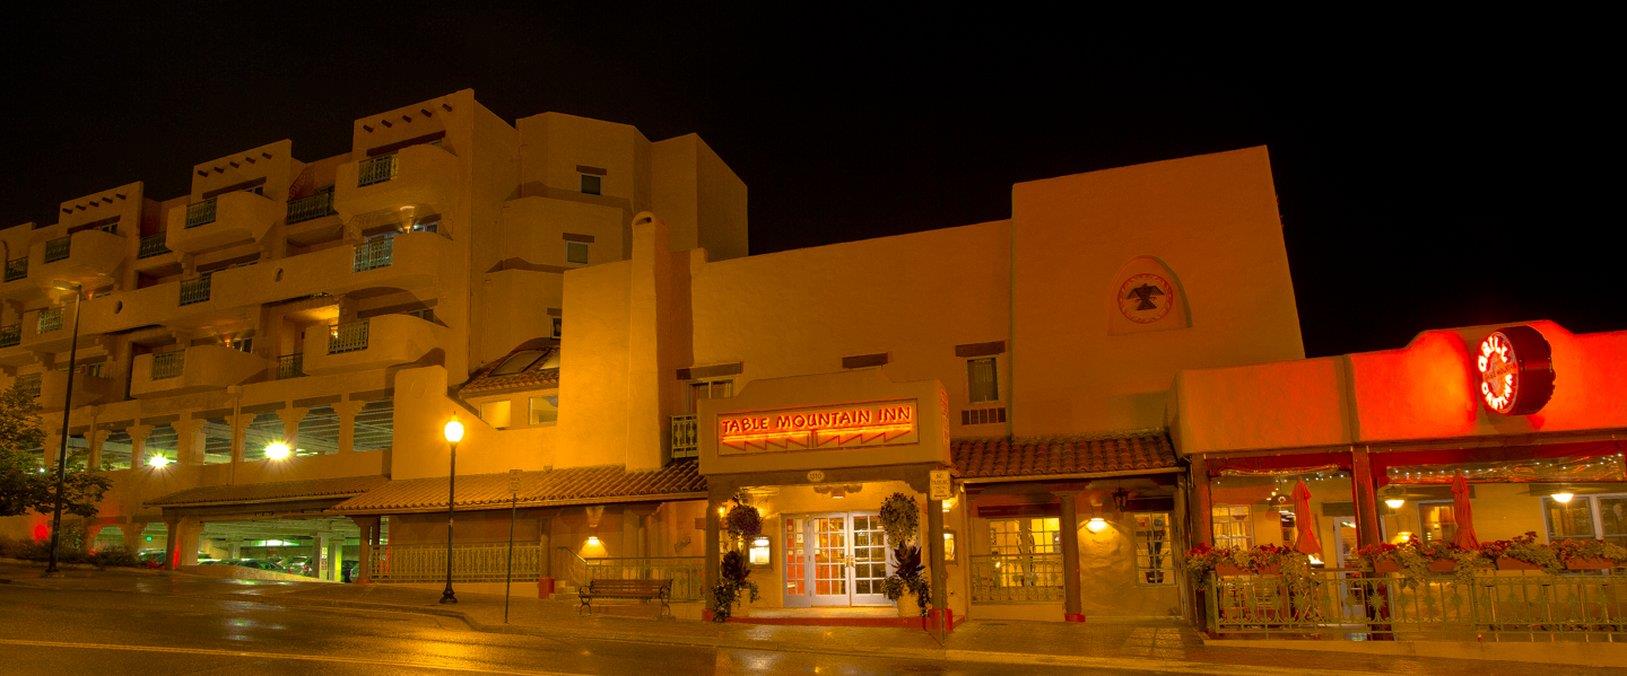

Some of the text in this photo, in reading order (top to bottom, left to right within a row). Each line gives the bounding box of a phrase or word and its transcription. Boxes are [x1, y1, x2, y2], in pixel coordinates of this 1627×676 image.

[1478, 335, 1507, 372] GRILL
[1481, 373, 1512, 410] CANTINA
[722, 405, 912, 433] TABLE MOUNTAIN INN
